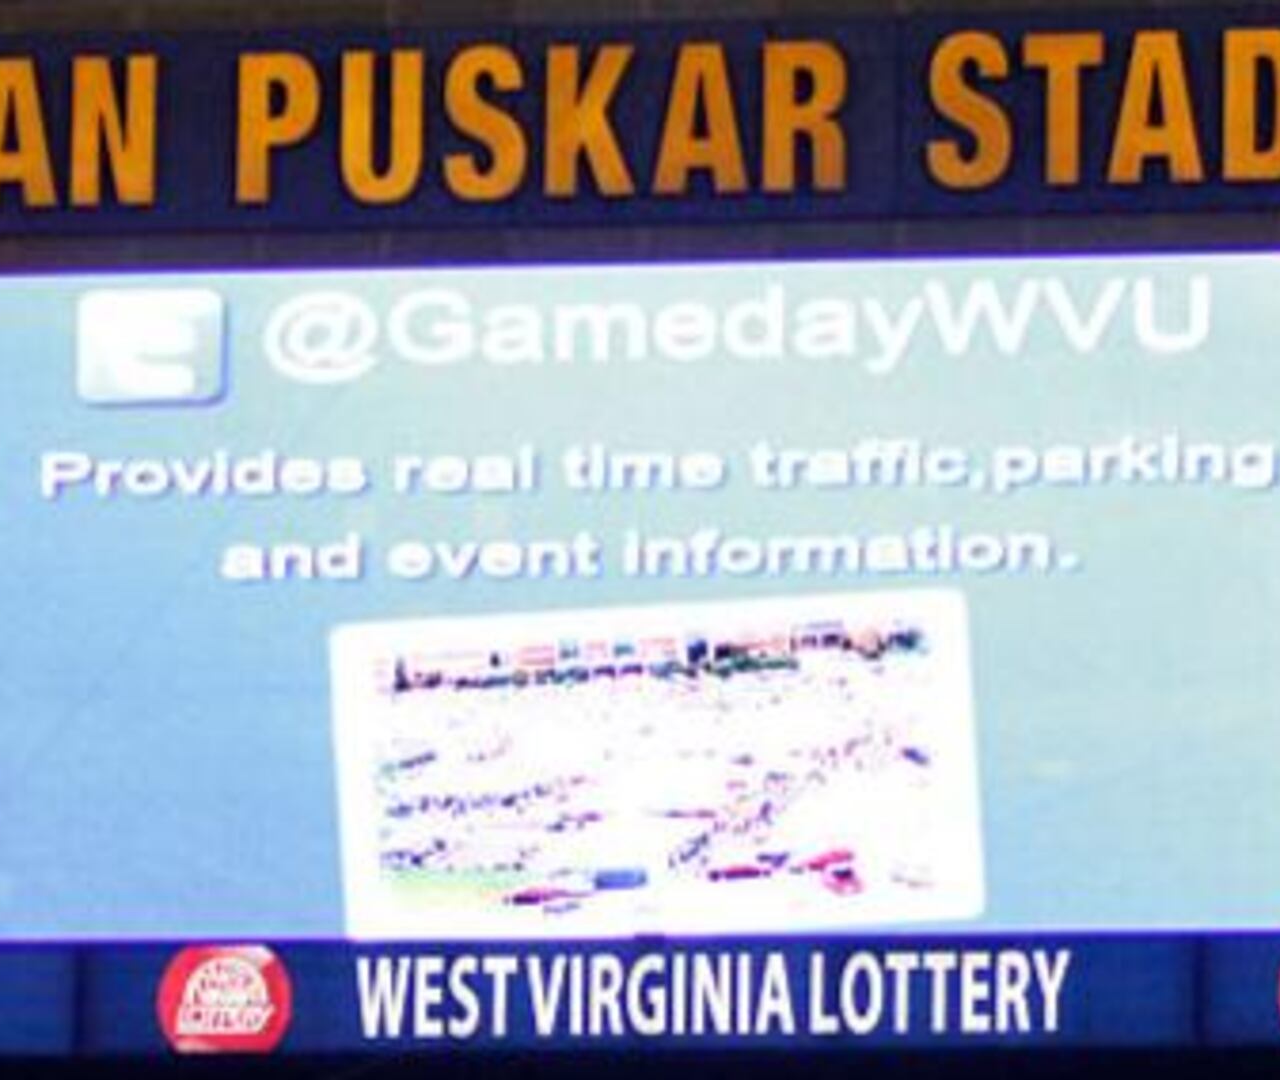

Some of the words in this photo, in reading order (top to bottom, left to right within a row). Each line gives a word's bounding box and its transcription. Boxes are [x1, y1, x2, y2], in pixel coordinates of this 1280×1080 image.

[235, 42, 847, 204] PUSKAR
[262, 275, 1211, 384] @GamedayWVU
[40, 447, 368, 500] Provides
[392, 444, 536, 492] real
[562, 442, 726, 490] time
[221, 531, 364, 580] and
[387, 532, 601, 579] event
[622, 523, 1080, 577] information.
[356, 956, 518, 1041] WEST
[526, 953, 793, 1040] VIRGINIA
[809, 950, 1071, 1036] LOTTERY
